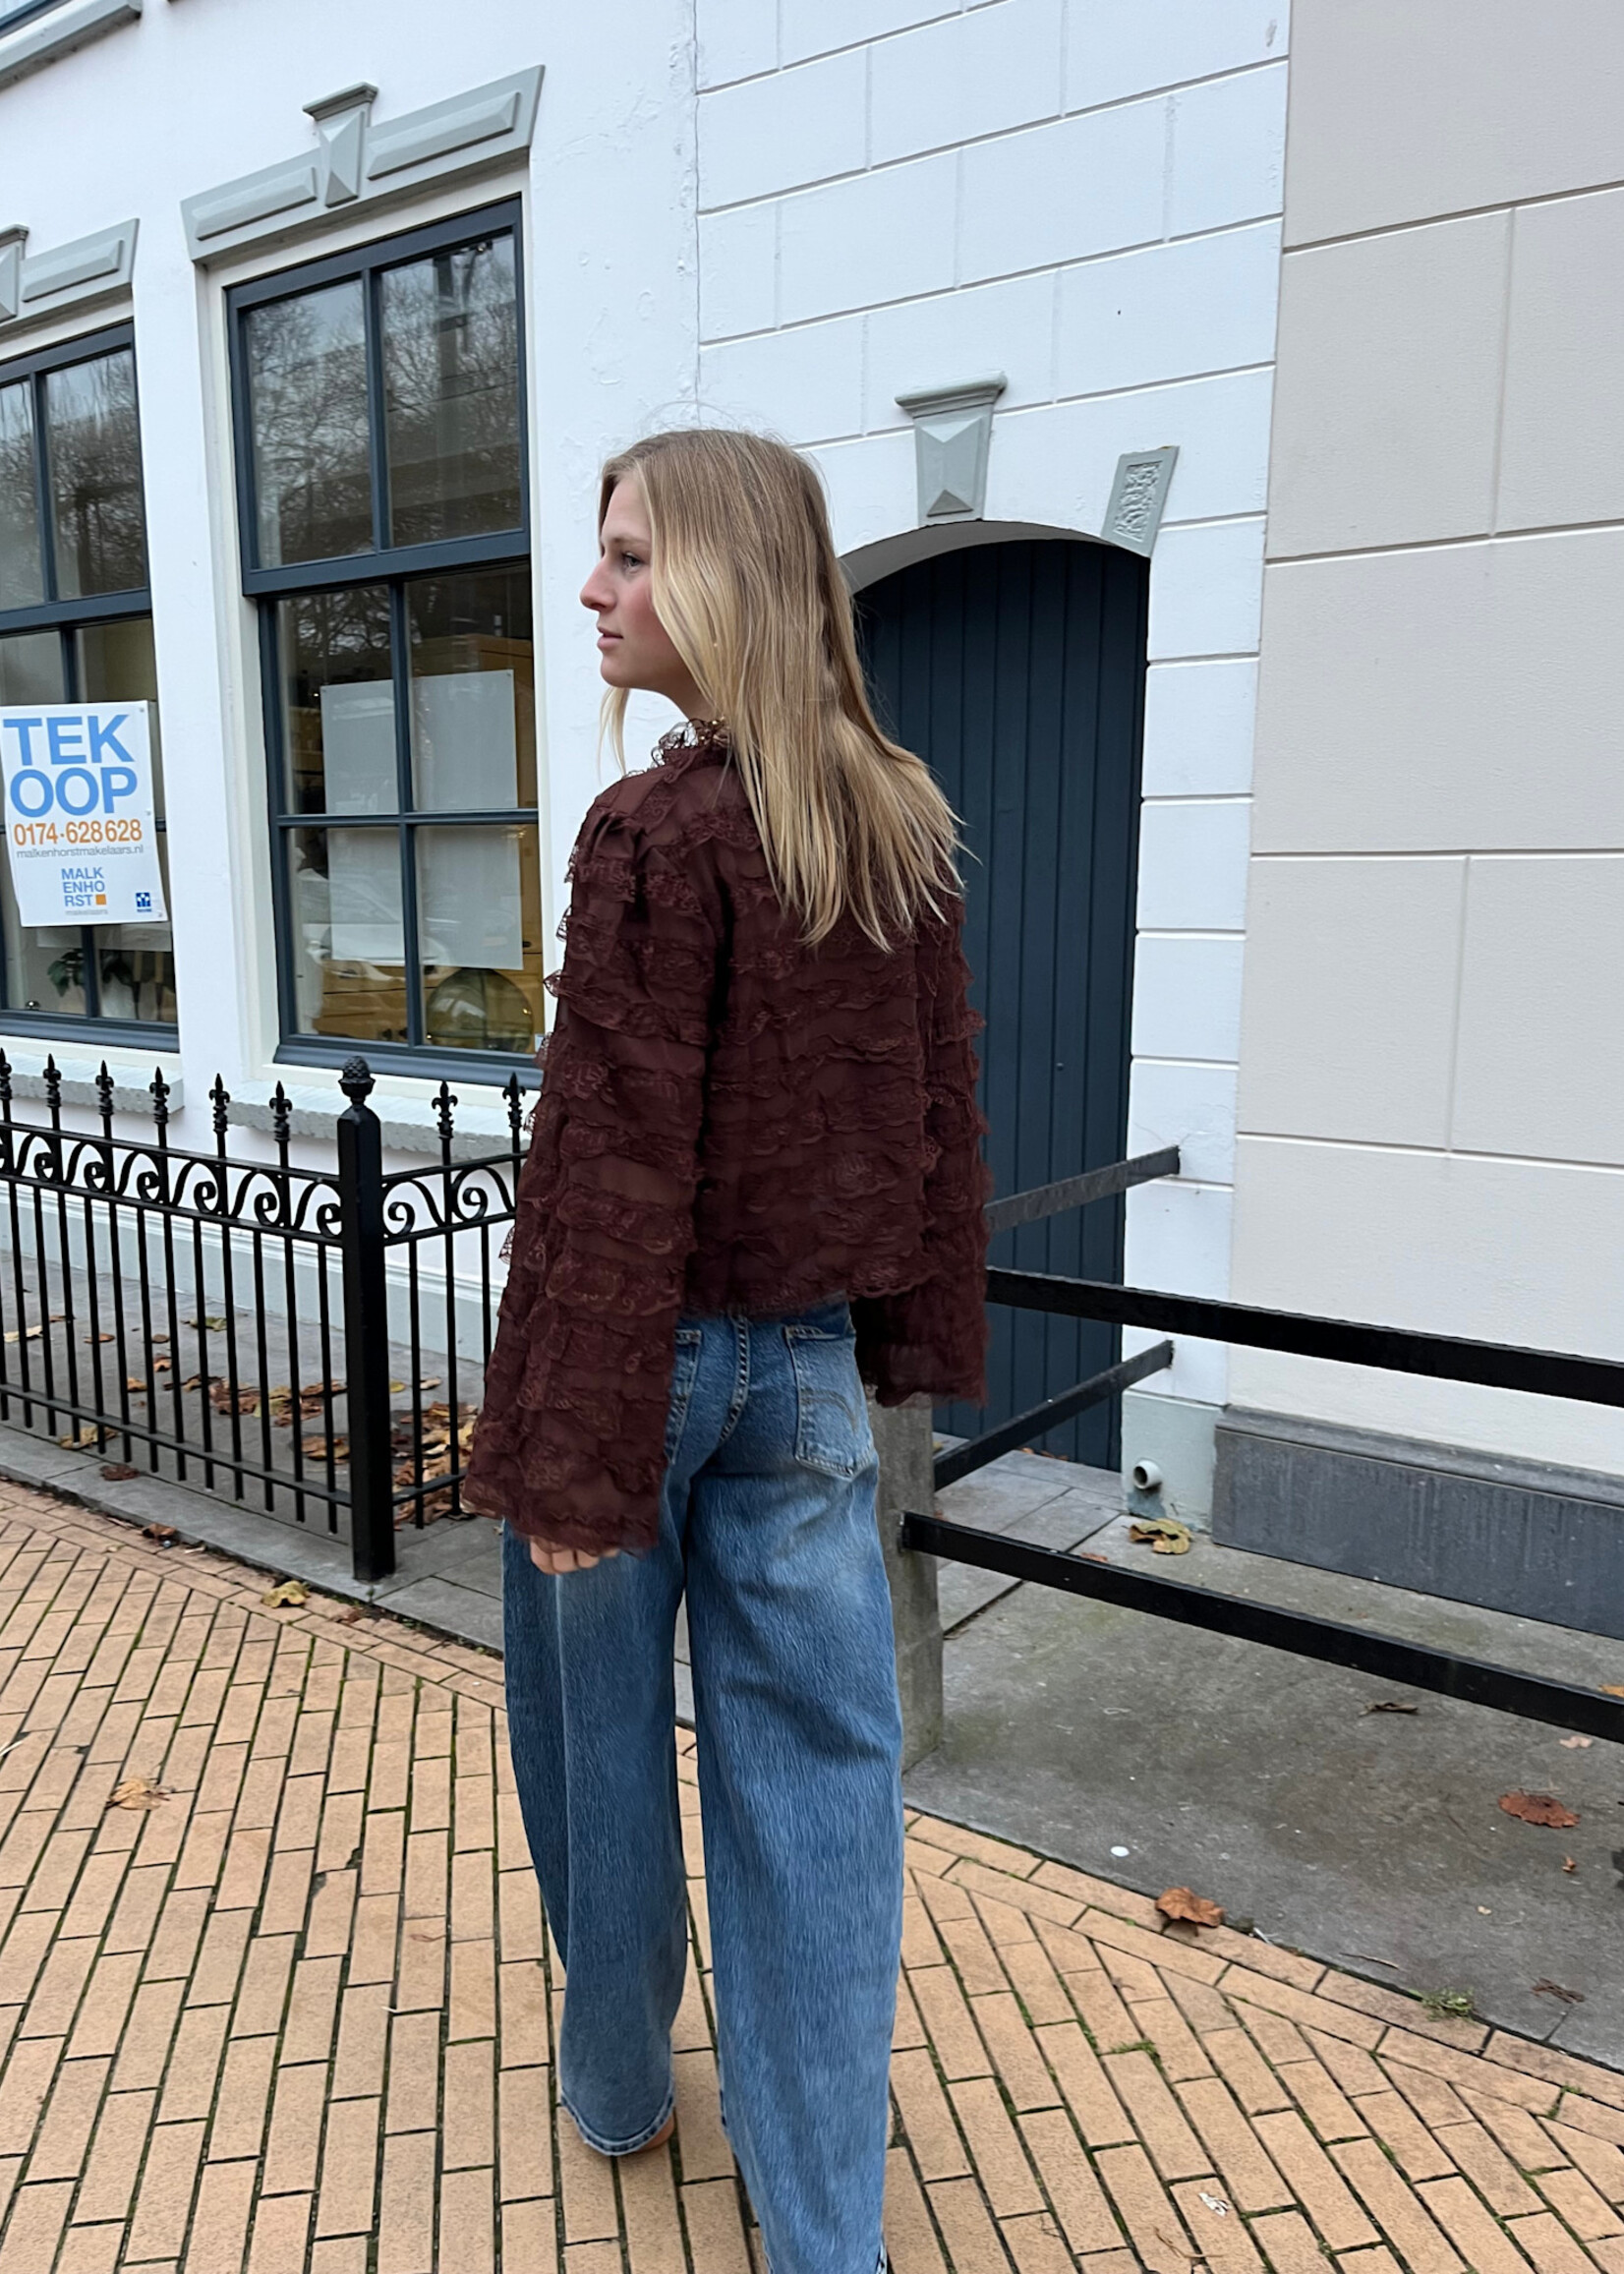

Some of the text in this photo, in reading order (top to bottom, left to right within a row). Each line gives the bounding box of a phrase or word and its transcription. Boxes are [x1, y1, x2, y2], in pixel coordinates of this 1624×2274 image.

[3, 715, 135, 766] TEK
[10, 767, 138, 817] OOP
[16, 845, 144, 858] malkenhorstmakelaars.nl
[61, 867, 104, 880] MALK
[63, 881, 105, 894] ENHO
[65, 895, 92, 906] RST
